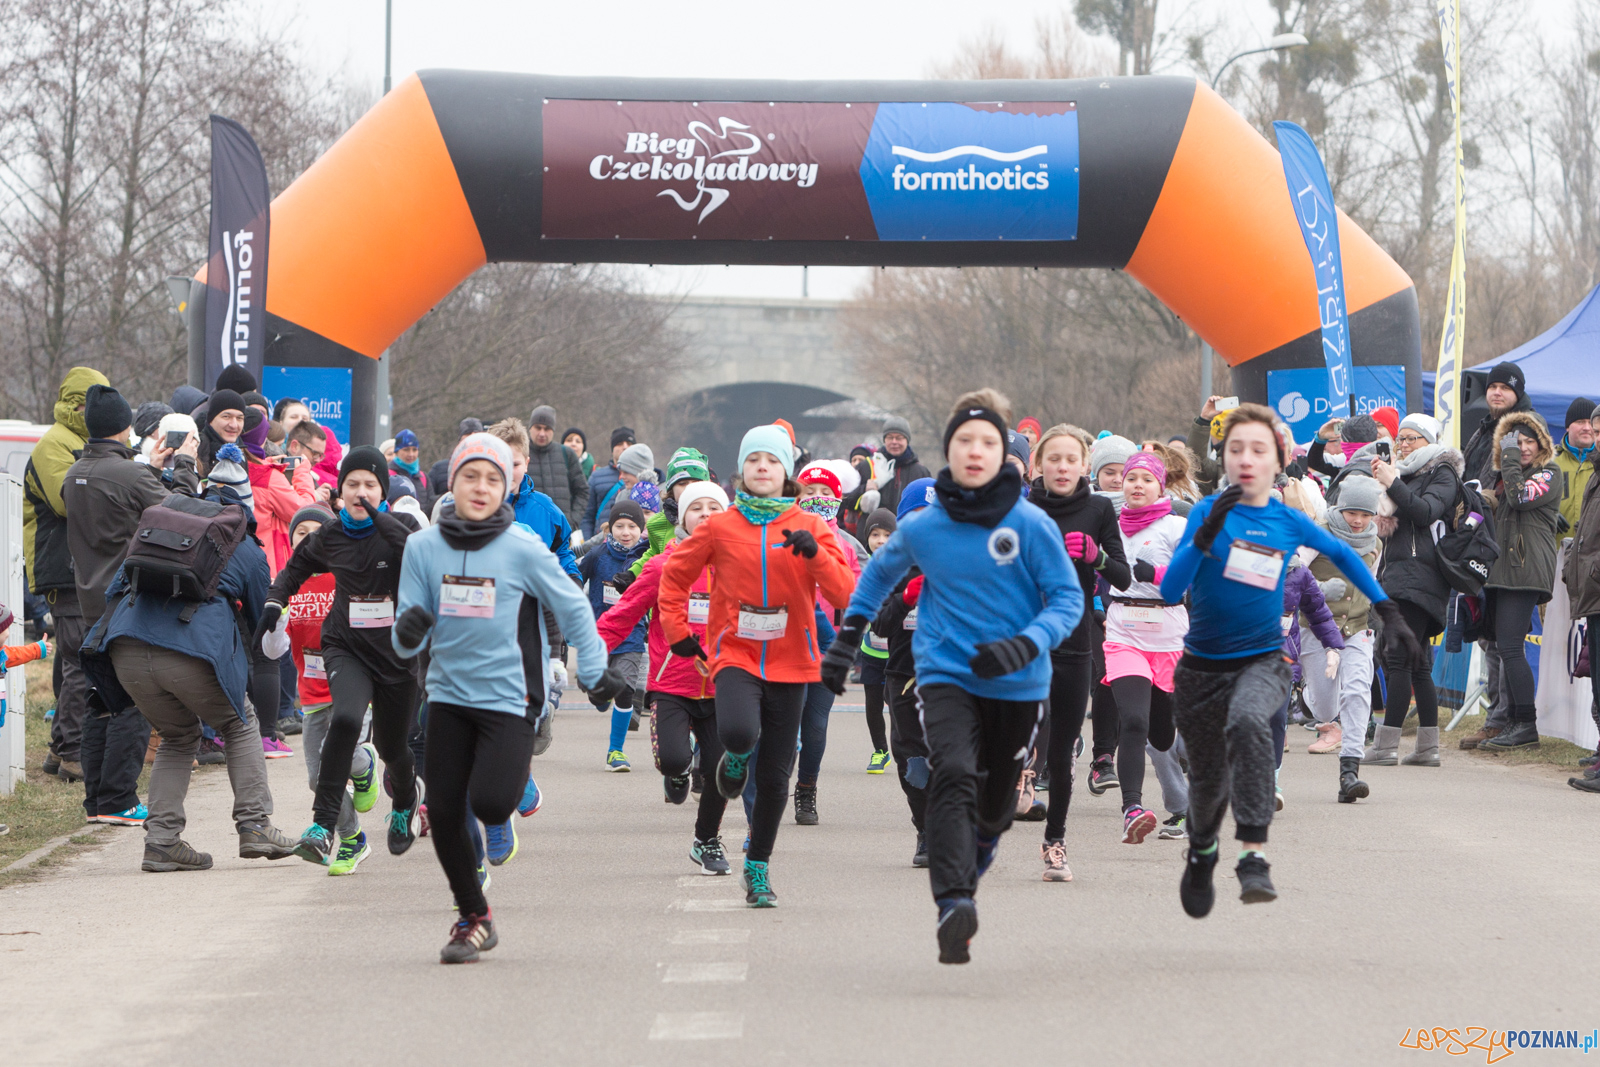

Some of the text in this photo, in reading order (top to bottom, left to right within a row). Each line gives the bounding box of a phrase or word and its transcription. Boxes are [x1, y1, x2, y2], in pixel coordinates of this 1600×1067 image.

[624, 131, 696, 160] Bieg
[589, 154, 819, 188] Czekoladowy
[892, 162, 1049, 191] formthotics
